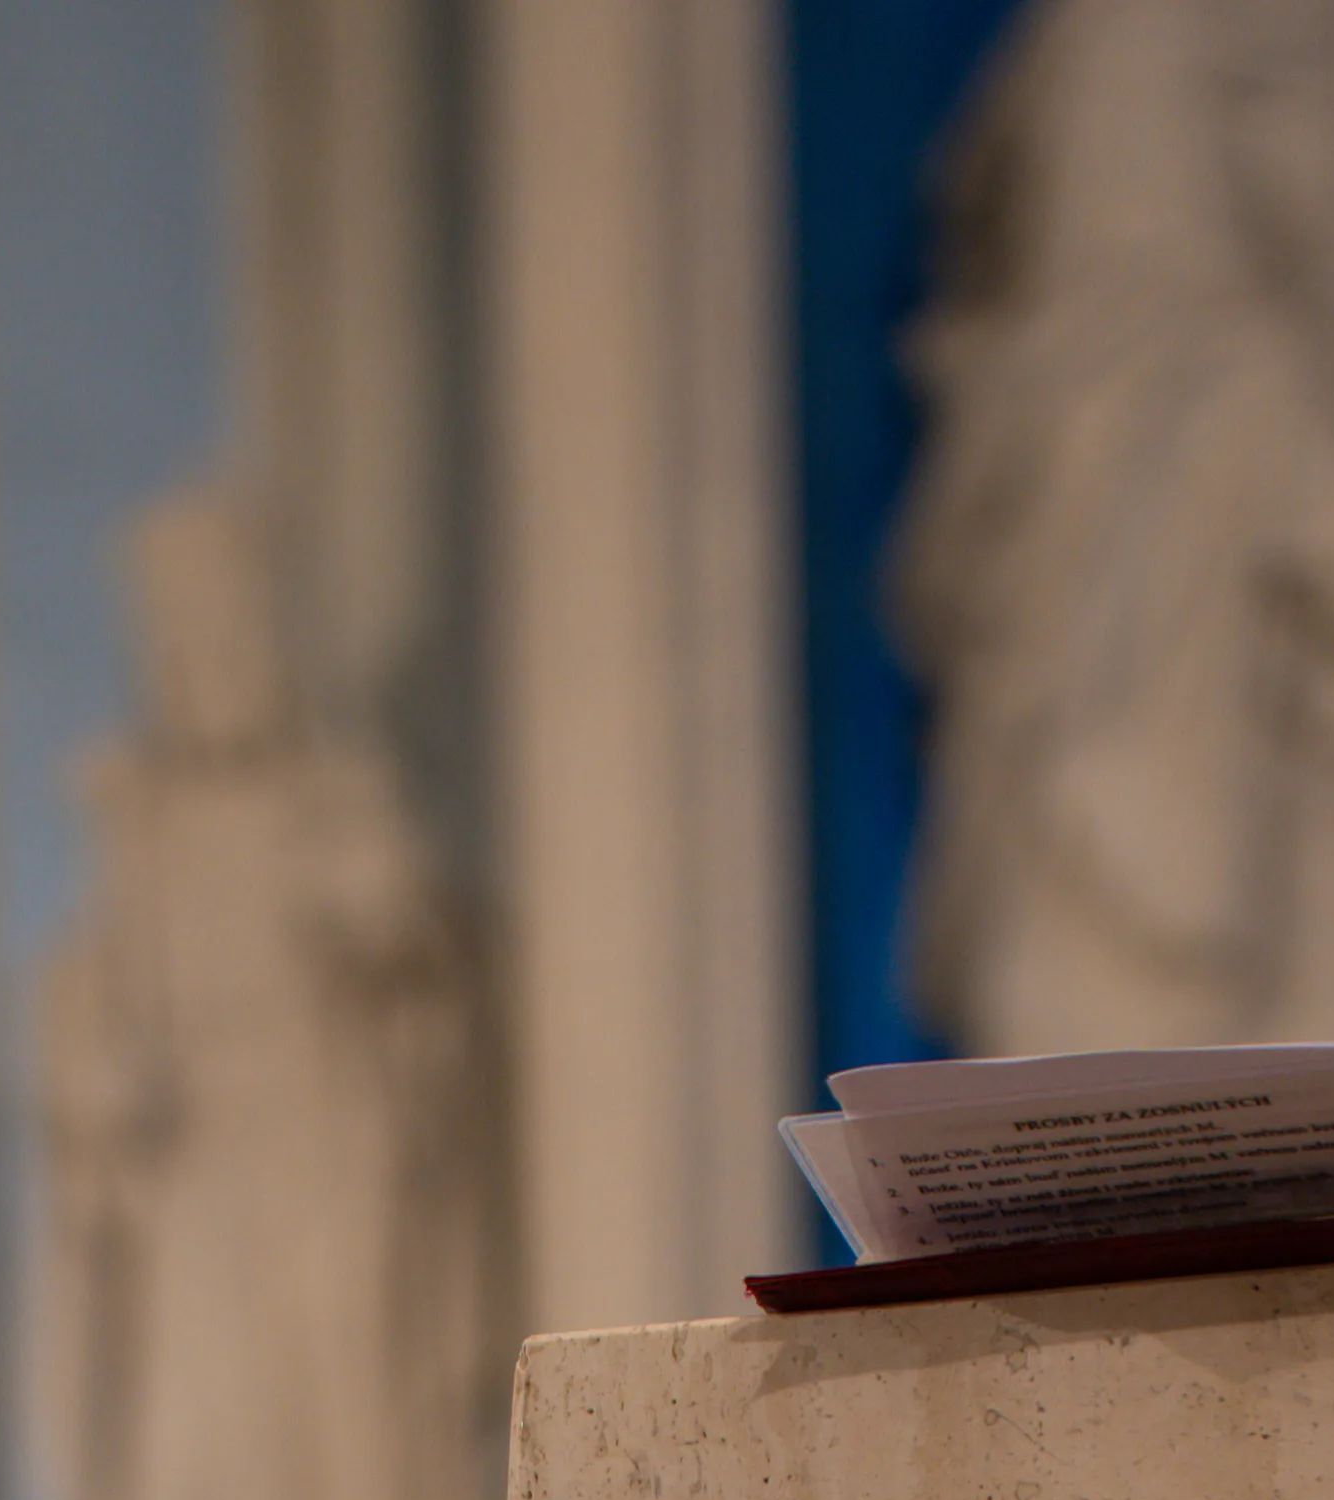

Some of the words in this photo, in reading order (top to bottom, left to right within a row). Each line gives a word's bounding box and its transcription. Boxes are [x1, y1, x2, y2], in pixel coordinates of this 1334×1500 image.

[1014, 1115, 1095, 1132] PROSBY
[1103, 1111, 1133, 1123] ZA
[1137, 1095, 1272, 1119] ZOSNULÝCH
